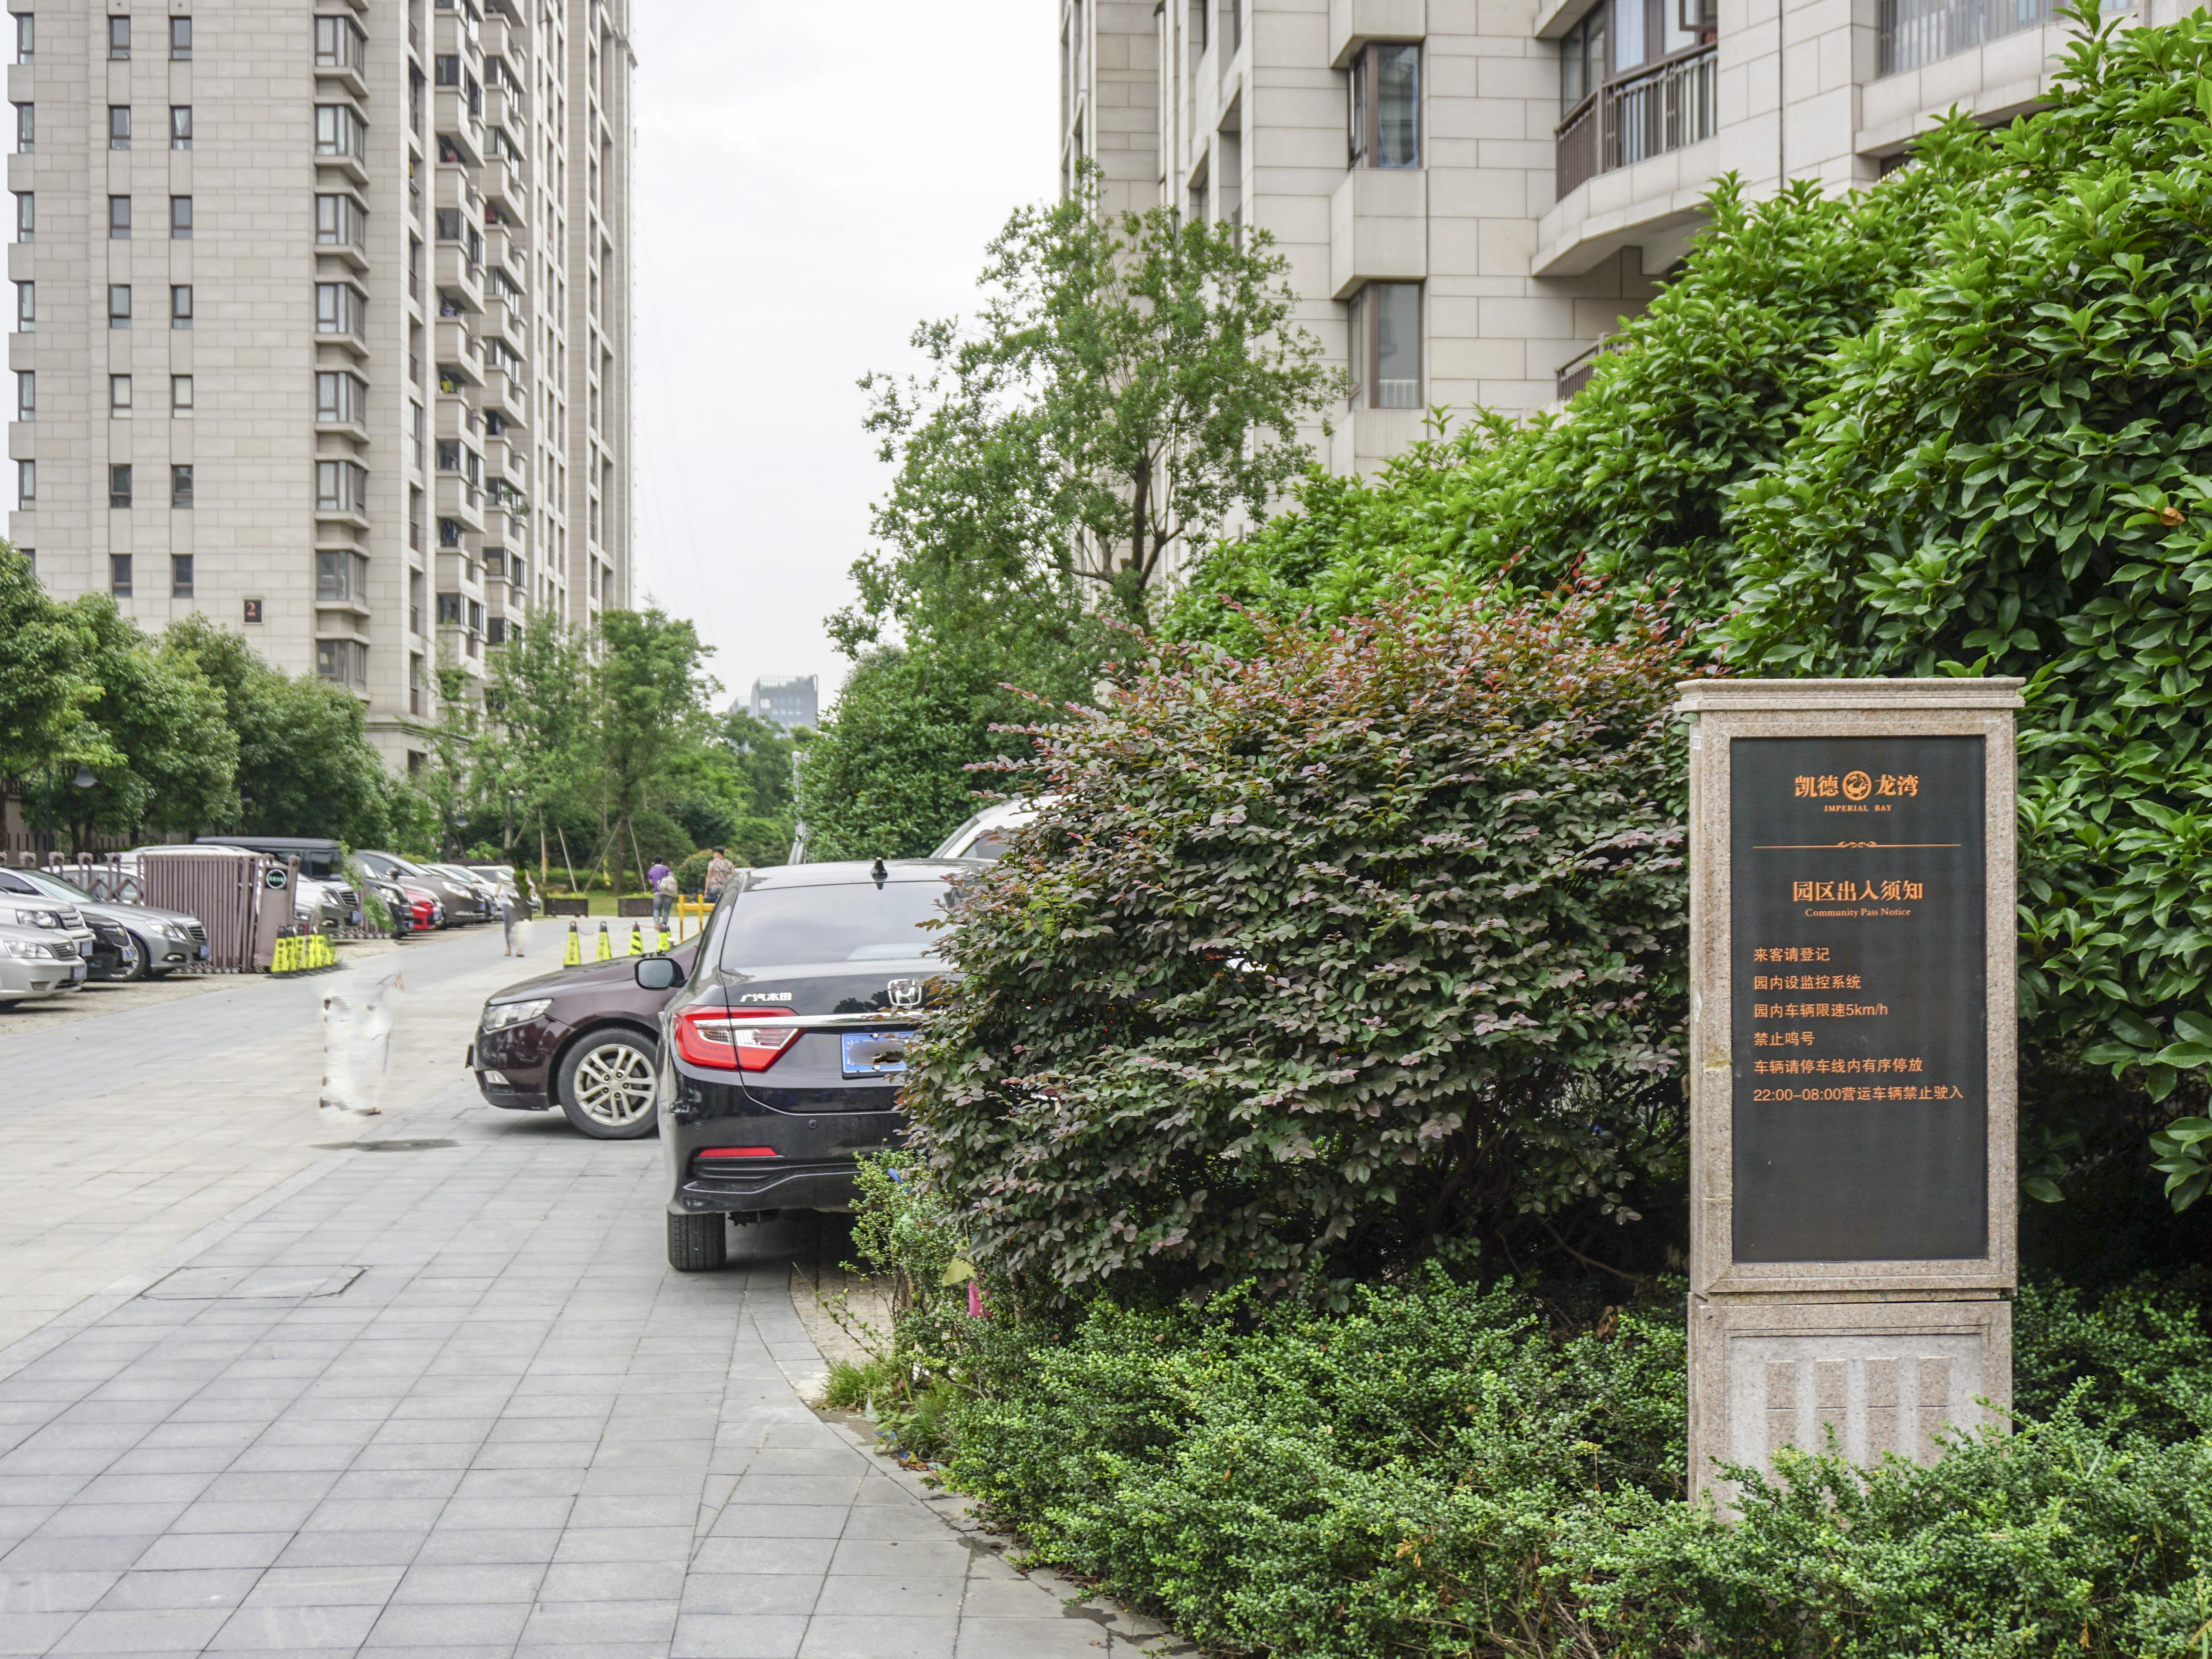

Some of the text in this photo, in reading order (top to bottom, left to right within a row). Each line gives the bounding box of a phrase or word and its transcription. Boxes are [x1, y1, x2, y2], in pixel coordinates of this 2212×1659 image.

[247, 601, 256, 617] 2
[1795, 774, 1919, 797] 凯德 龙湾
[1805, 908, 1858, 918] Community
[1881, 907, 1911, 916] Notice
[1754, 947, 1830, 962] 来客请登记
[1754, 974, 1861, 990] 园内设监控系统
[740, 993, 792, 1002] 广汽本田
[1754, 1003, 1888, 1018] 园内车辆限速5km/h
[1754, 1031, 1815, 1047] 禁止鸣号
[1754, 1058, 1923, 1074] 车辆请停车线内有序停放
[1753, 1085, 1963, 1101] 22:00-08:00营运车辆禁止驶入
